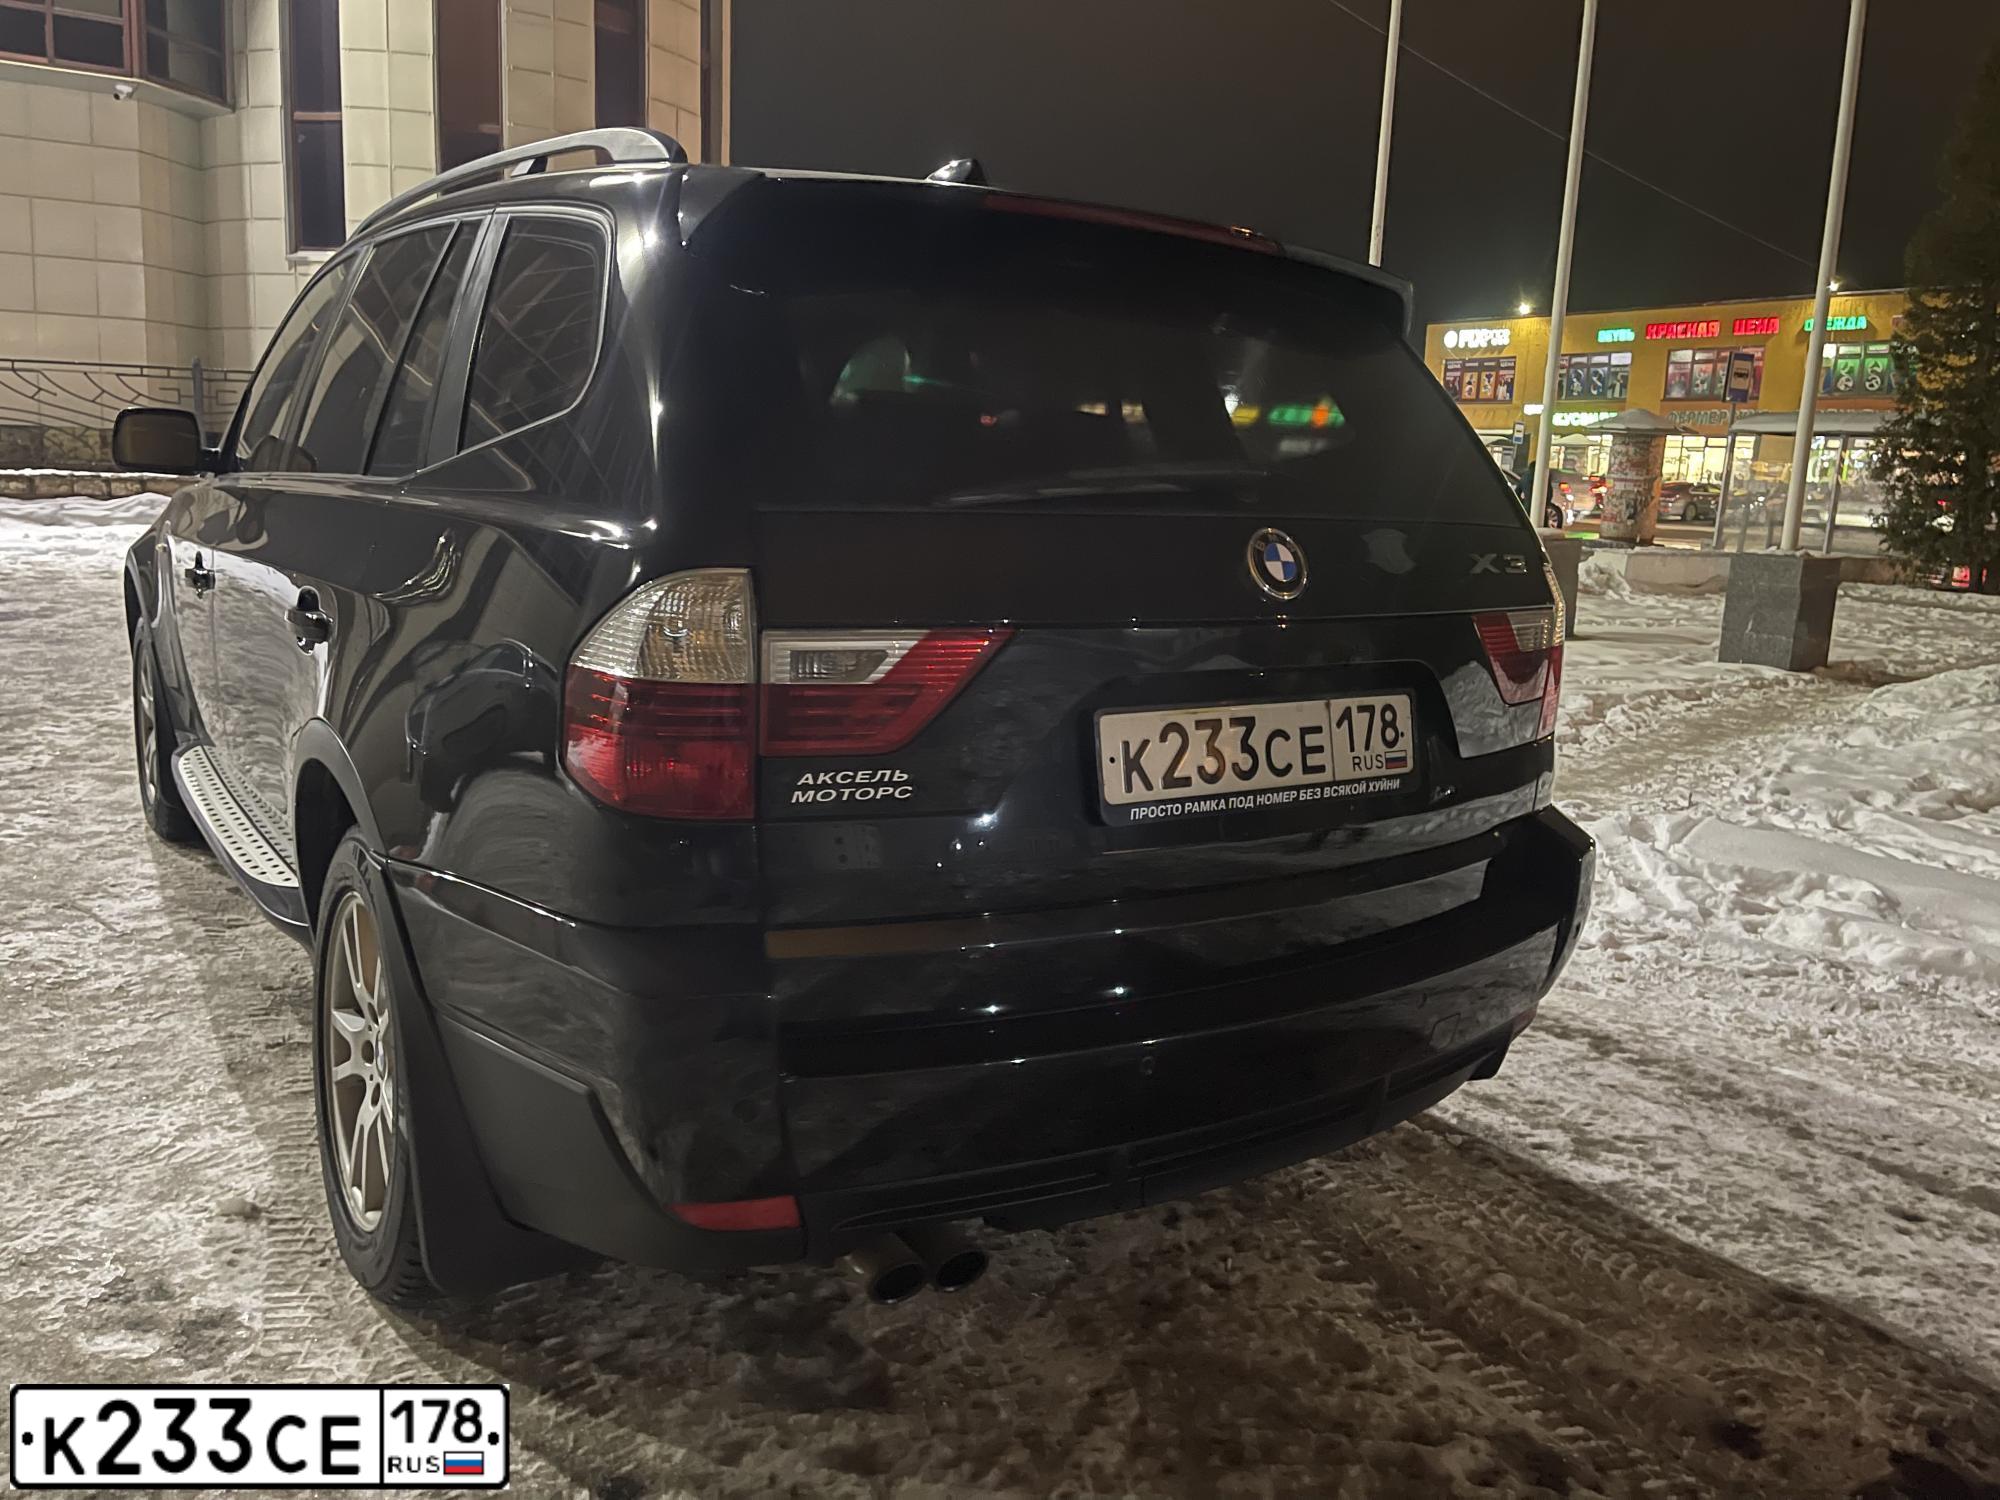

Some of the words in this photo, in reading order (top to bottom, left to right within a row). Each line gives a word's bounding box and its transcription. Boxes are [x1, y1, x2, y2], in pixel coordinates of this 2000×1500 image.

[1646, 320, 1720, 340] КРАСНАЯ
[1733, 317, 1779, 336] ЦЕНА
[1804, 316, 1867, 331] ОЕЖДА
[1469, 552, 1528, 575] X3
[1121, 716, 1326, 794] К233СЕ
[1336, 703, 1399, 752] 178
[1352, 754, 1384, 771] RUS
[797, 770, 909, 785] АКСЕЛЬ
[791, 786, 913, 803] МОТОРС
[1130, 804, 1182, 821] ПРОСТО
[1184, 798, 1226, 815] РАМКА
[1229, 795, 1254, 810] ПОД
[1256, 790, 1297, 806] НОМЕР
[1299, 788, 1321, 801] БЕЗ
[1323, 781, 1366, 798] ВСЯКОЙ
[1367, 778, 1400, 793] ХУЙНИ
